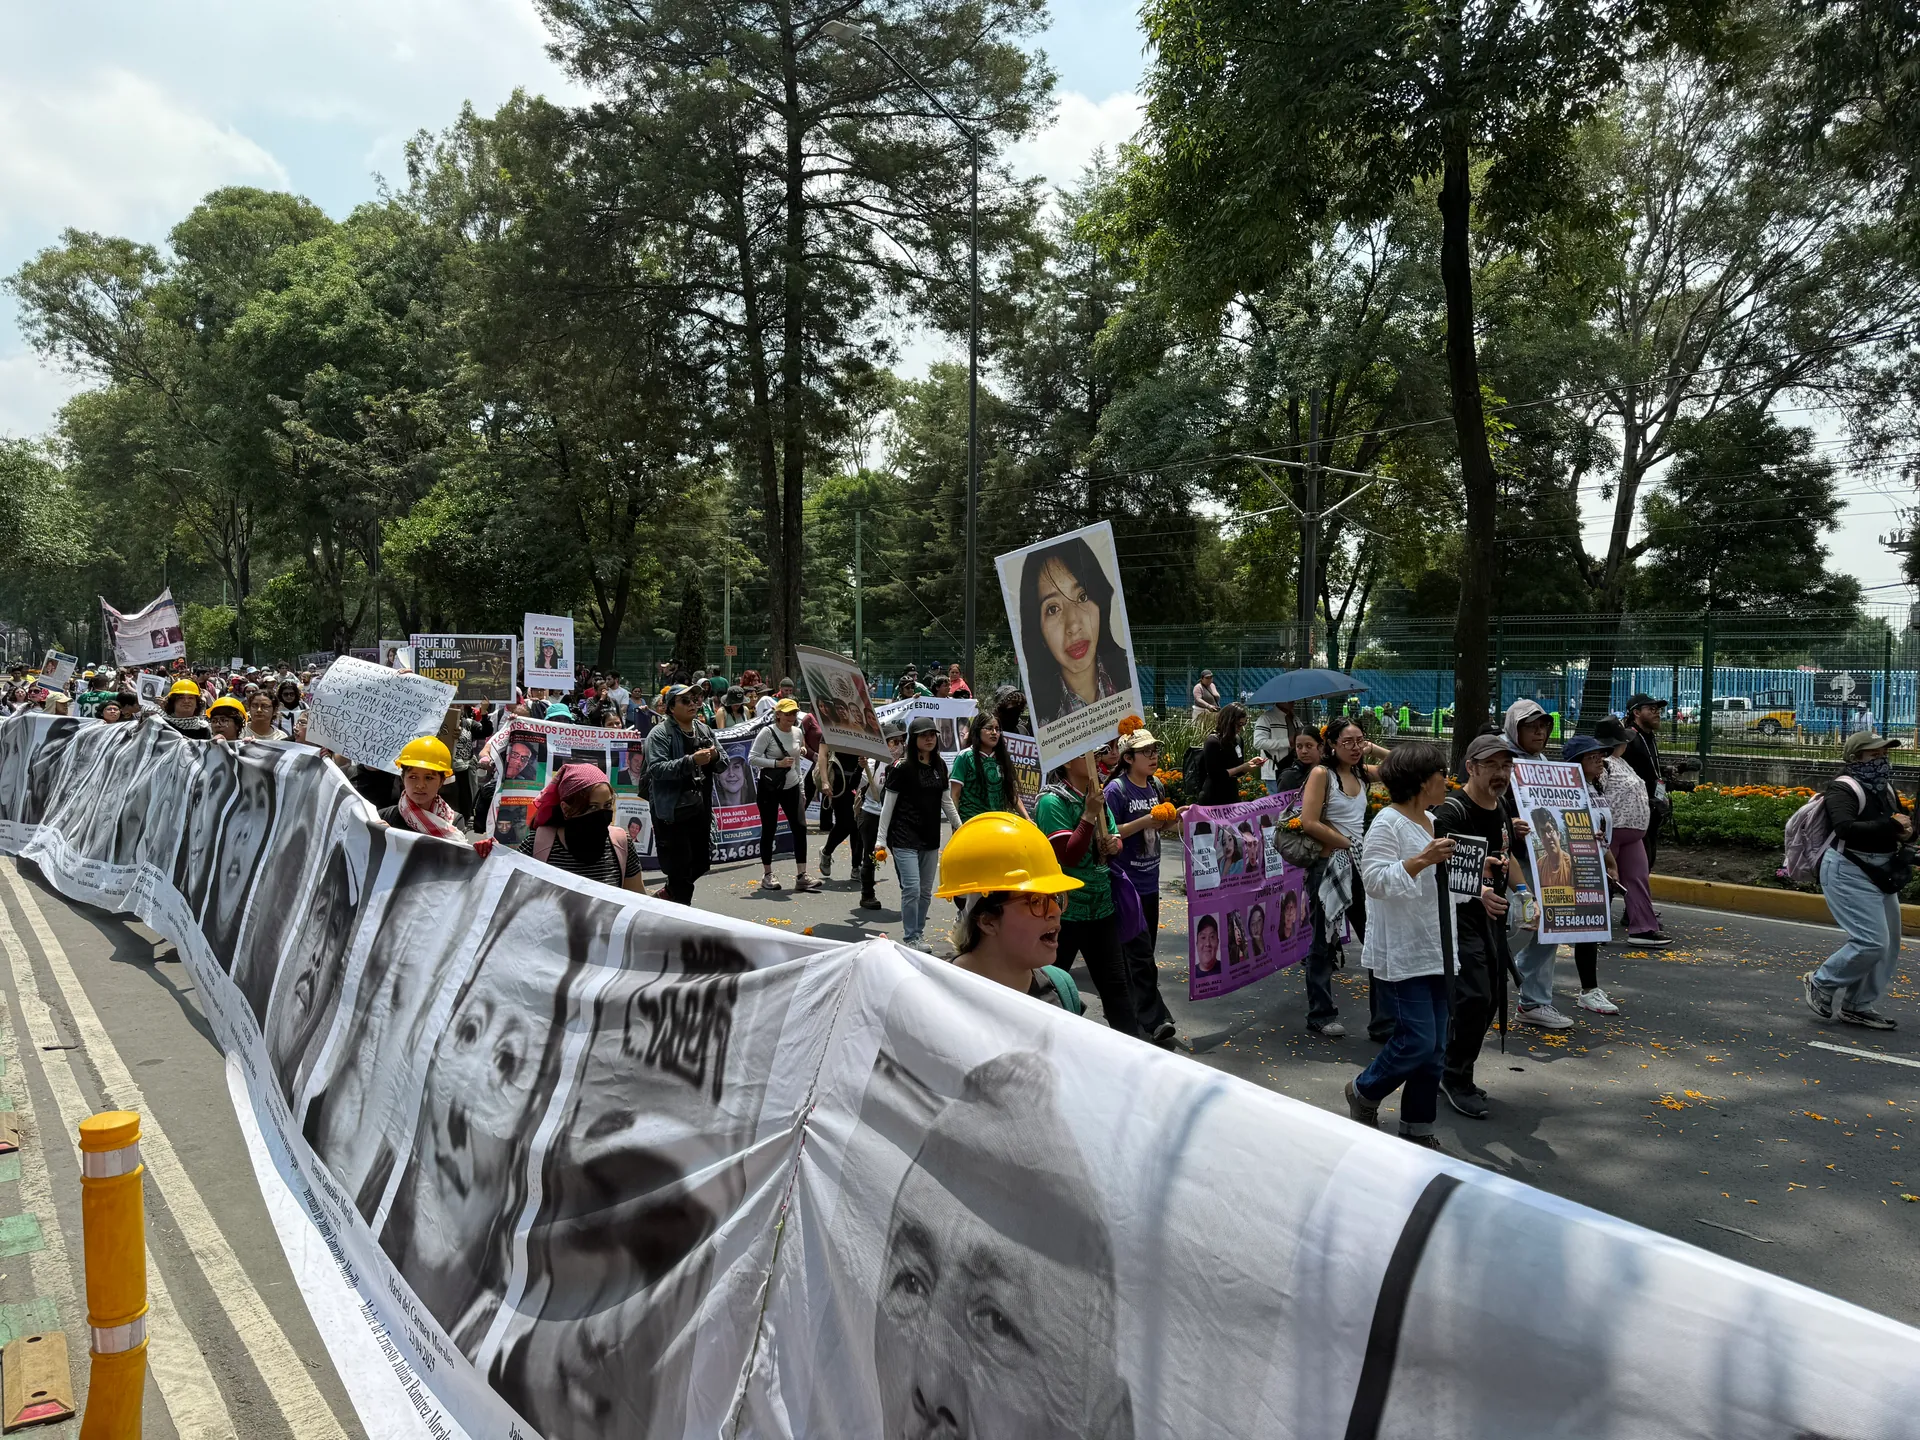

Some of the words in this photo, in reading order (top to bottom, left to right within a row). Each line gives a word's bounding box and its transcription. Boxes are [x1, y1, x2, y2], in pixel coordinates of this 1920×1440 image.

[442, 638, 455, 648] NO
[419, 650, 429, 659] SE
[431, 650, 461, 659] JUEGUE
[419, 659, 436, 667] CON
[420, 668, 465, 679] NUESTRO
[1823, 693, 1862, 701] coyocán
[915, 701, 940, 710] ESTADIO
[1046, 719, 1067, 734] Mariela
[1066, 711, 1088, 724] Vanessa
[1100, 696, 1124, 709] Valverde
[1041, 727, 1076, 747] desaparecida
[1082, 720, 1089, 728] 21
[1089, 716, 1096, 724] de
[1096, 711, 1109, 722] abril
[1108, 707, 1117, 717] del
[1117, 702, 1132, 713] 2018
[1065, 738, 1071, 746] la
[1092, 718, 1119, 734] Iztapalapa
[560, 727, 596, 739] PORQUE
[598, 731, 615, 739] LOS
[829, 727, 853, 738] MADRES
[864, 735, 885, 745] AJUSCO
[1004, 738, 1039, 757] ENTE
[1517, 763, 1576, 787] URGENTE
[1540, 800, 1573, 808] LOCALIZAR
[1565, 812, 1591, 827] OLIN
[1544, 895, 1574, 905] RECOMPENSA
[1555, 916, 1565, 927] 55
[1565, 915, 1585, 926] 5484
[1586, 914, 1605, 926] 0430
[358, 1299, 380, 1325] Madre
[370, 1321, 386, 1336] de
[401, 1297, 412, 1316] del
[410, 1306, 431, 1345] Carmen
[430, 1330, 455, 1370] Morales
[376, 1330, 401, 1364] Ernesto
